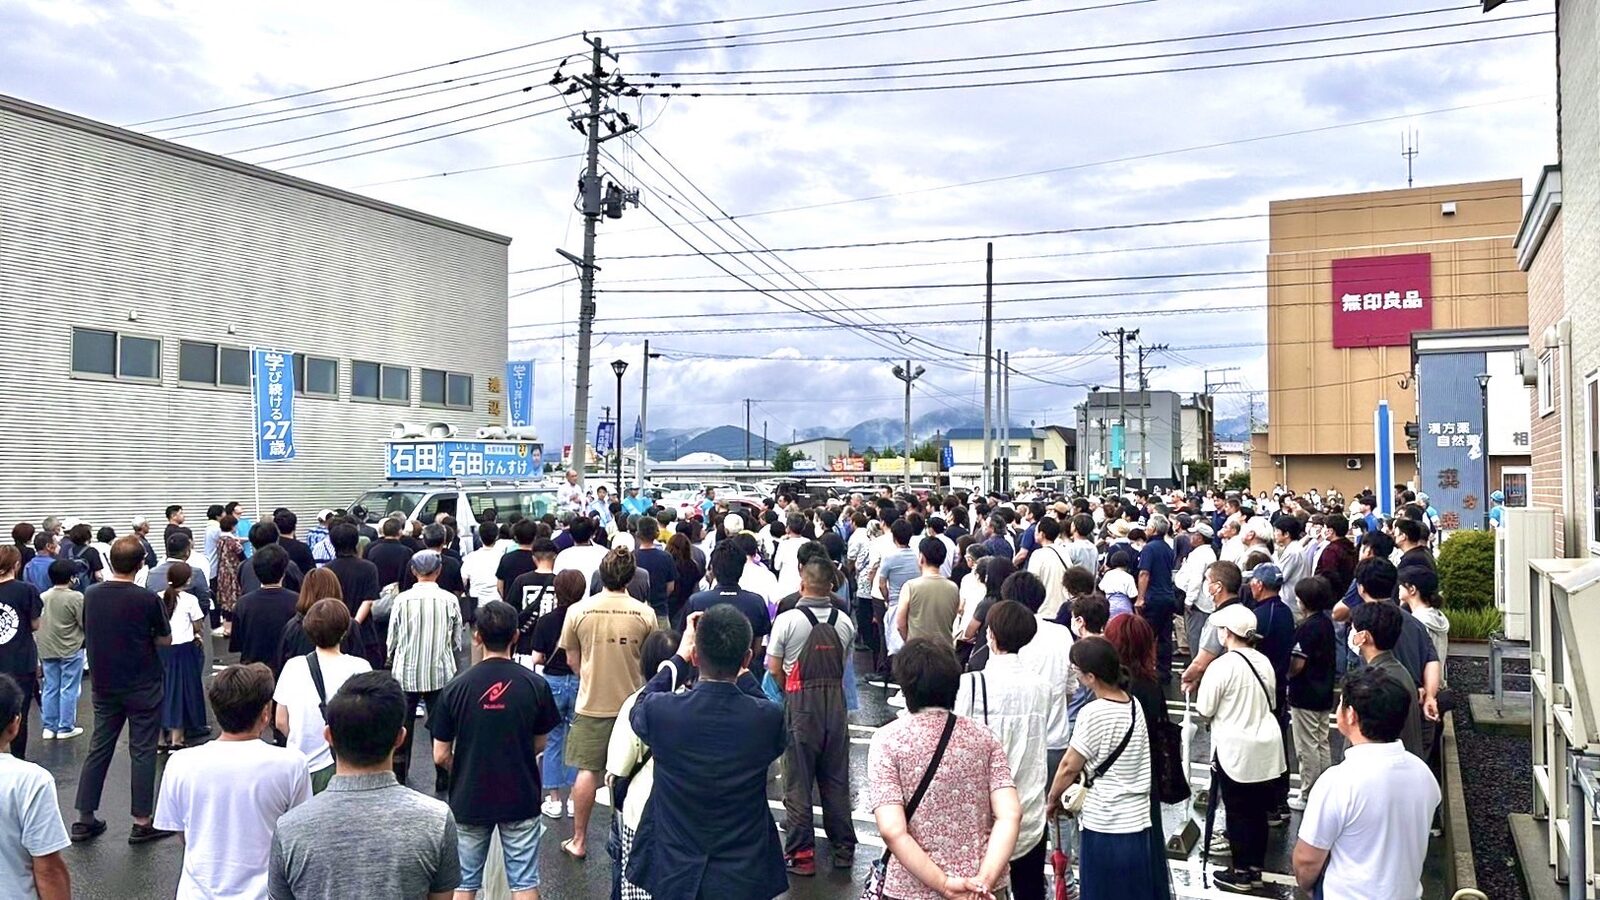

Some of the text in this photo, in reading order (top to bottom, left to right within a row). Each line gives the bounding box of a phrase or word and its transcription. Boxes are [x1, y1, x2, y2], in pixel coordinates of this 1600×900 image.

[1342, 291, 1423, 312] 無印良品
[1428, 421, 1470, 434] 漢方薬
[1513, 431, 1529, 446] 相
[392, 444, 437, 473] 石田
